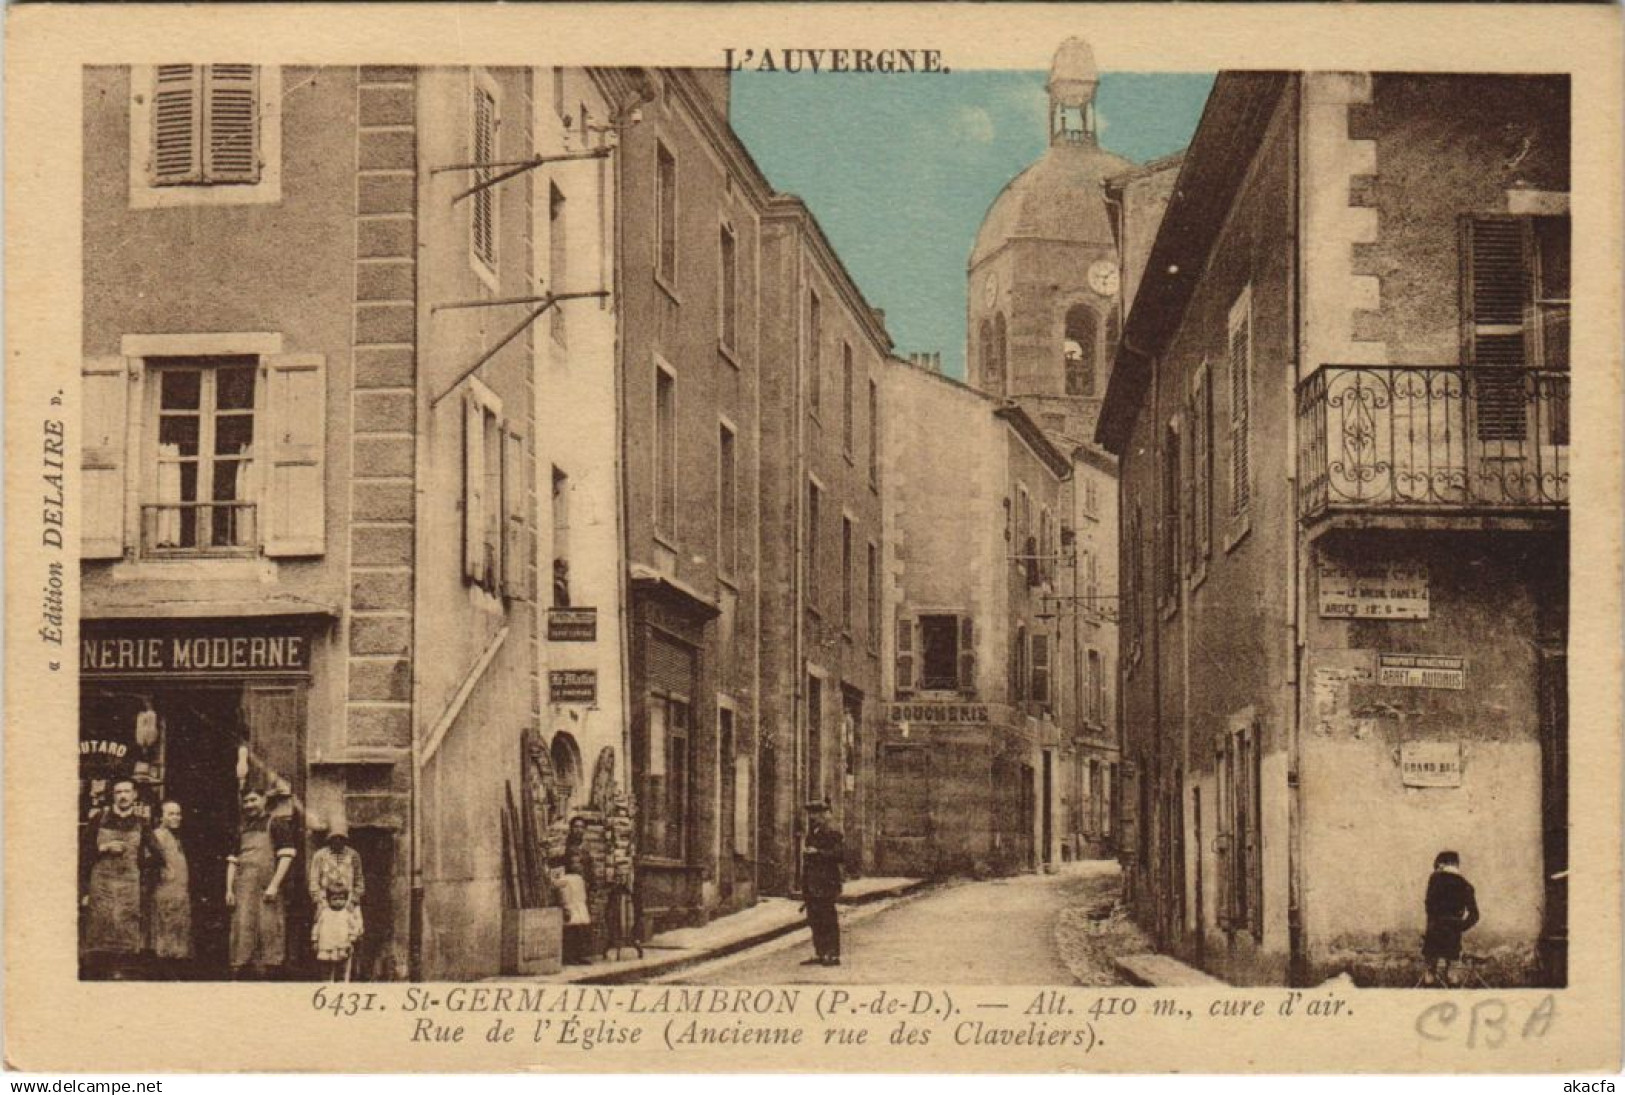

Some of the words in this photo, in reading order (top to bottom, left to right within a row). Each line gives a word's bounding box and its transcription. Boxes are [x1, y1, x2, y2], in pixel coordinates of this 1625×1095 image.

[82, 638, 164, 669] NERIE
[172, 636, 304, 669] MODERNE
[78, 739, 127, 758] UTARD
